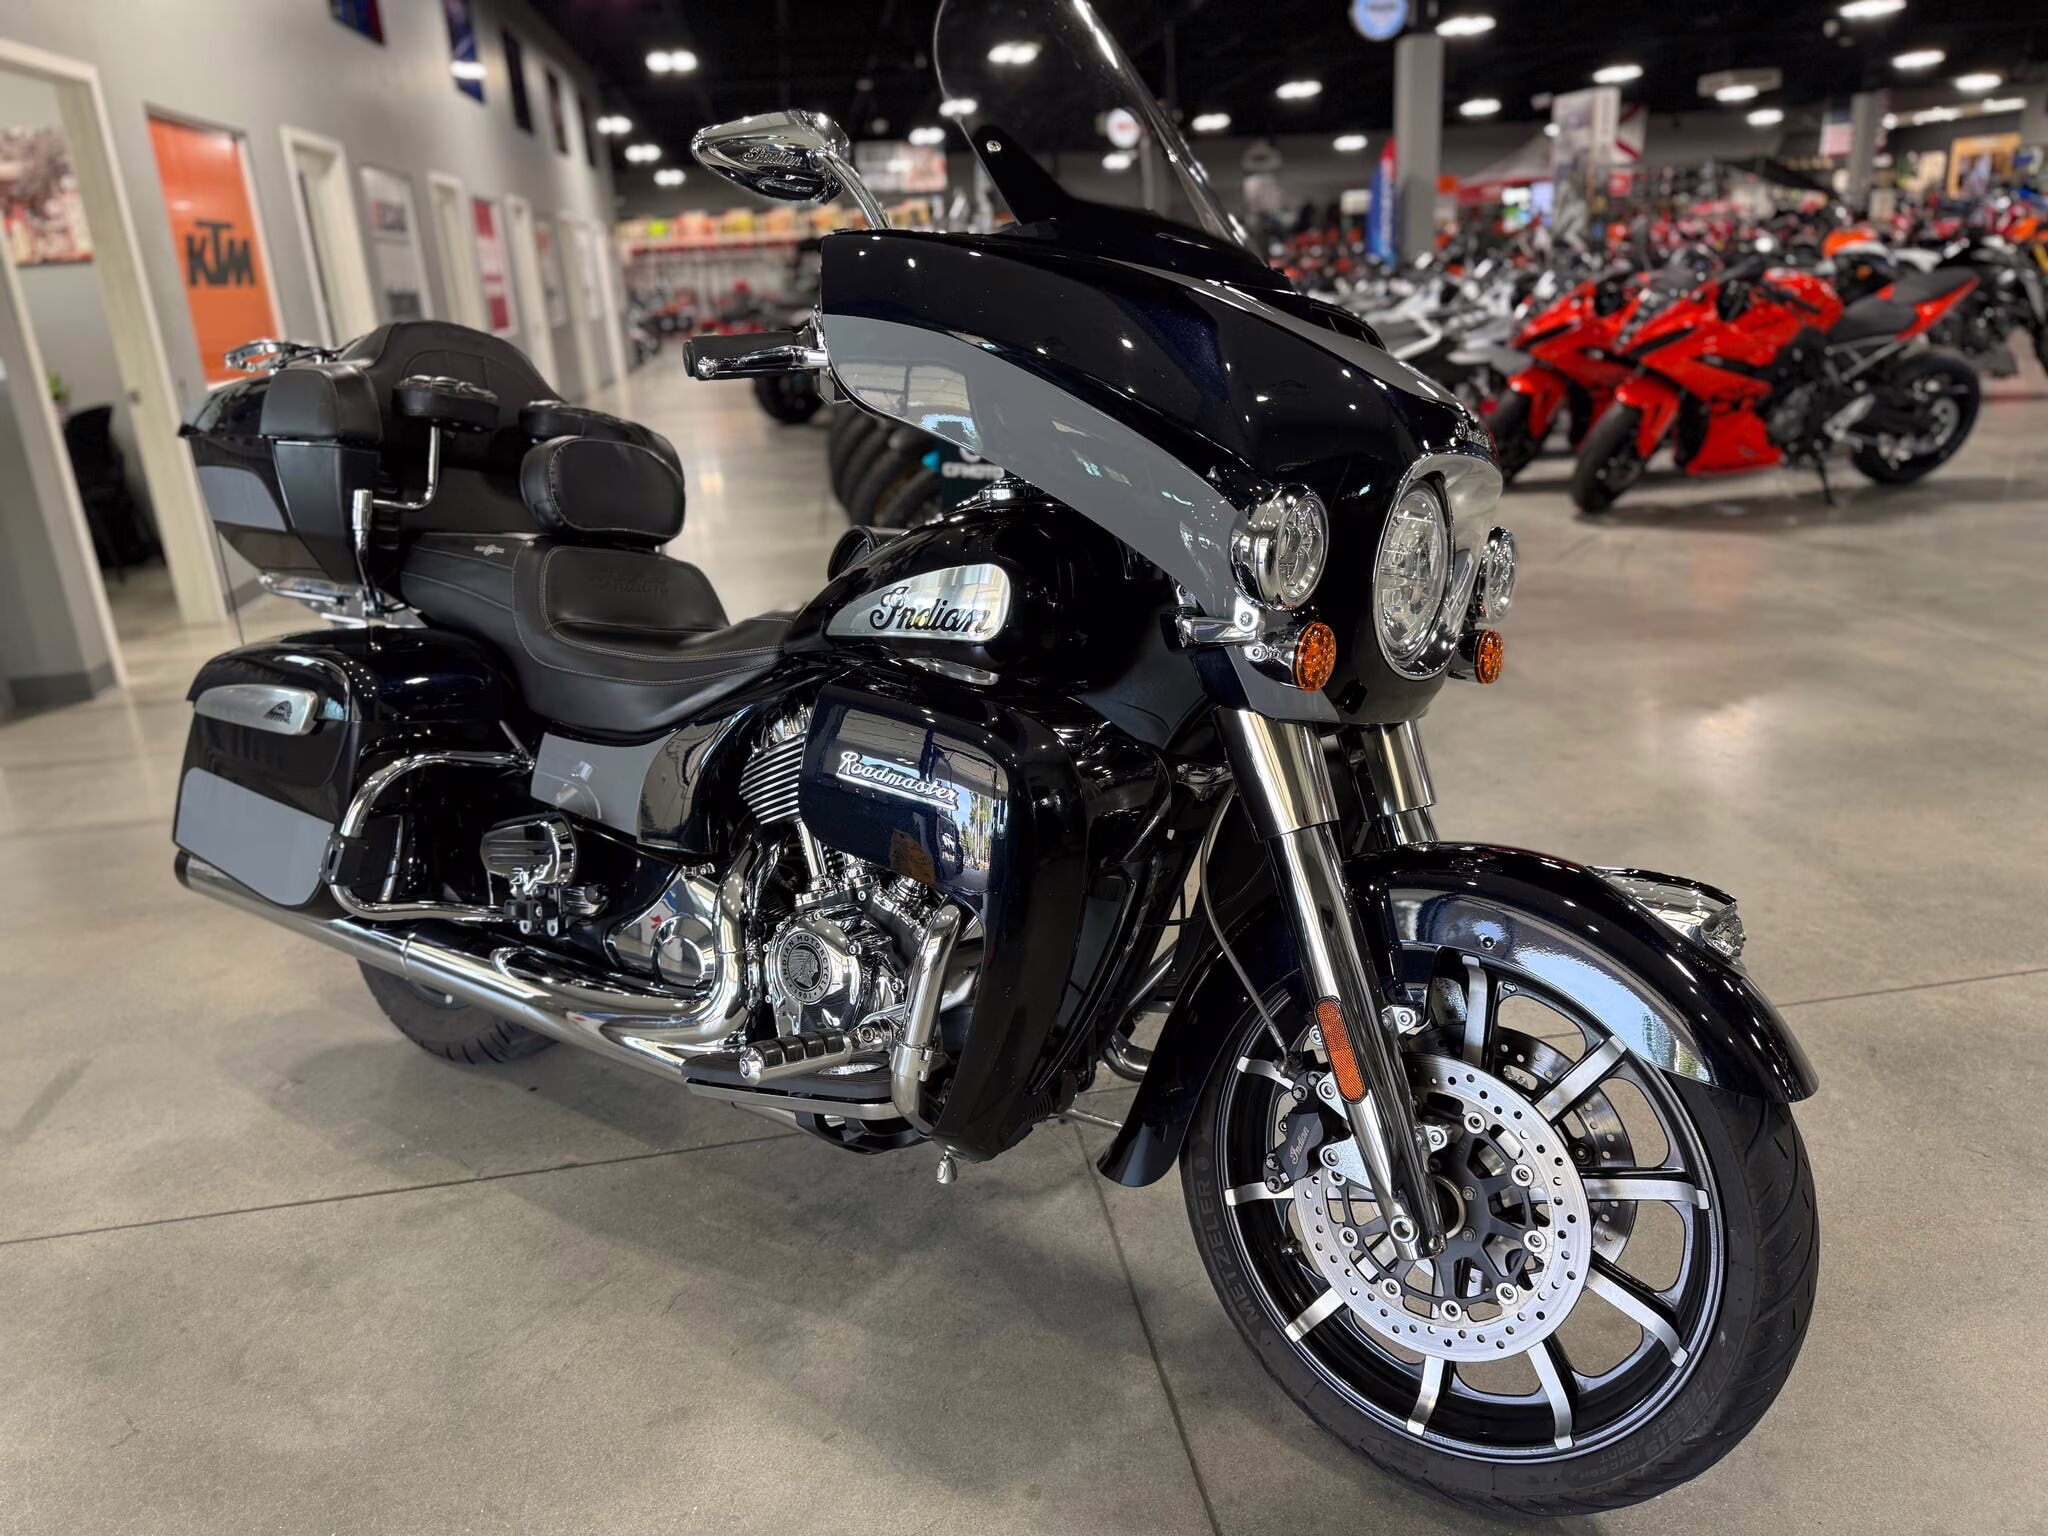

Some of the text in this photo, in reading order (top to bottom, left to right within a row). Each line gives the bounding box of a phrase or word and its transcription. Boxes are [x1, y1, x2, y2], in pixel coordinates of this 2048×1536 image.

[185, 219, 256, 287] KTM
[869, 586, 990, 634] Indian
[838, 751, 960, 803] Roadmaster
[796, 935, 830, 992] MOTORCYCLE
[1290, 1126, 1310, 1165] Indian
[1197, 1176, 1260, 1324] METZELER
